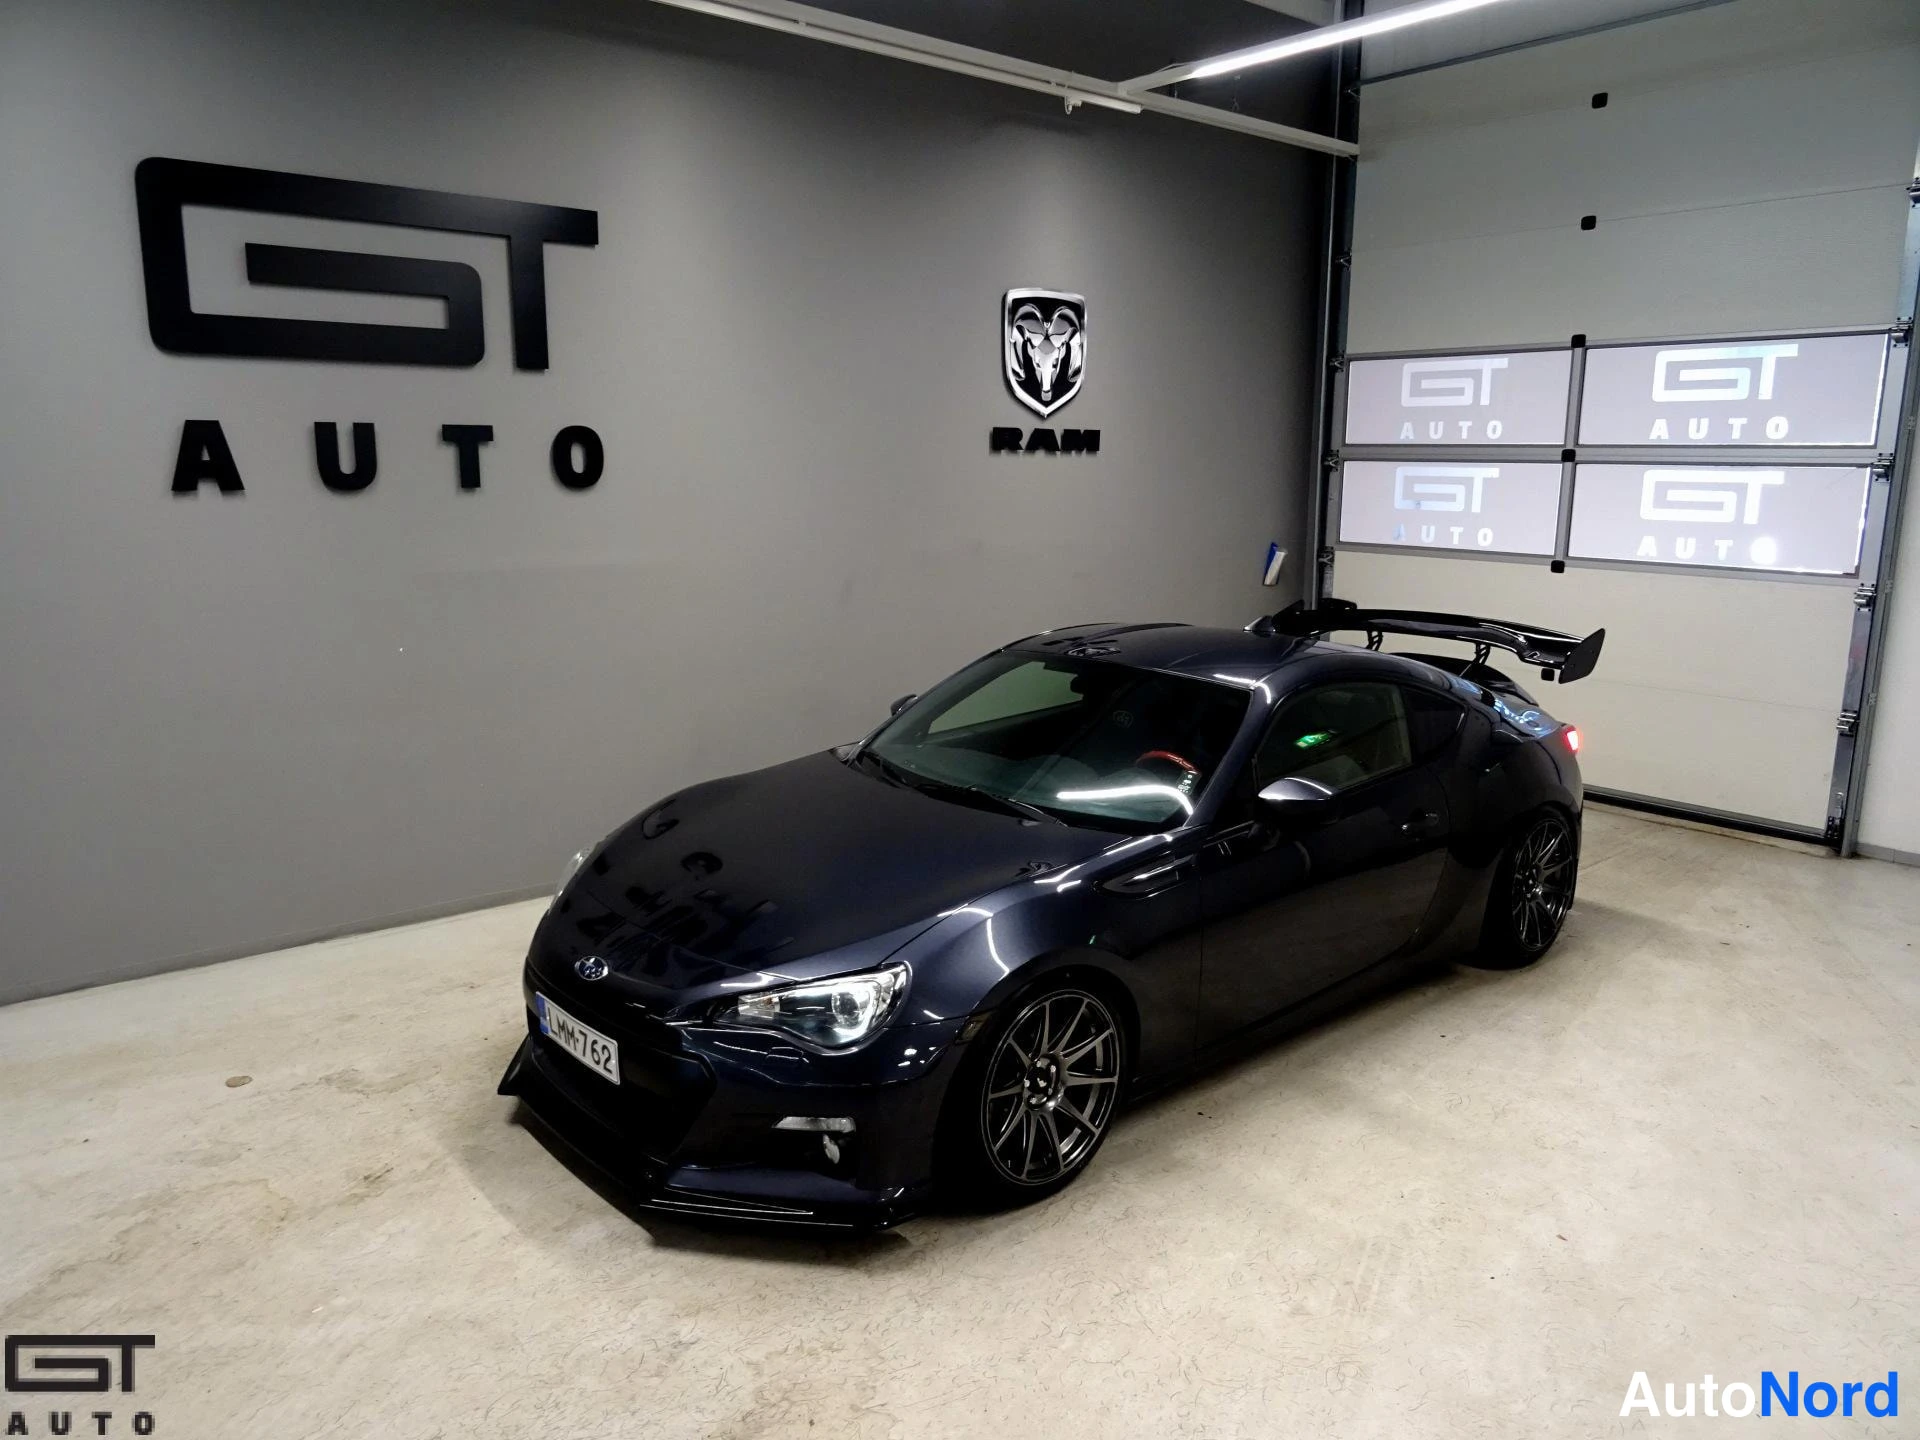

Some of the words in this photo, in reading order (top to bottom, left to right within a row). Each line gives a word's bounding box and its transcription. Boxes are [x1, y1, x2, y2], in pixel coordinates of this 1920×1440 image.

[135, 157, 598, 370] GT
[1401, 358, 1508, 407] GT
[1652, 344, 1798, 402] GT
[990, 427, 1101, 454] RAM
[1400, 420, 1502, 439] AUTO
[1649, 416, 1788, 439] AUTO
[171, 420, 604, 492] AUTO
[1394, 466, 1499, 513] GT
[1640, 470, 1784, 524] GT
[1393, 524, 1493, 546] AUTO
[548, 1007, 613, 1074] LMM-762
